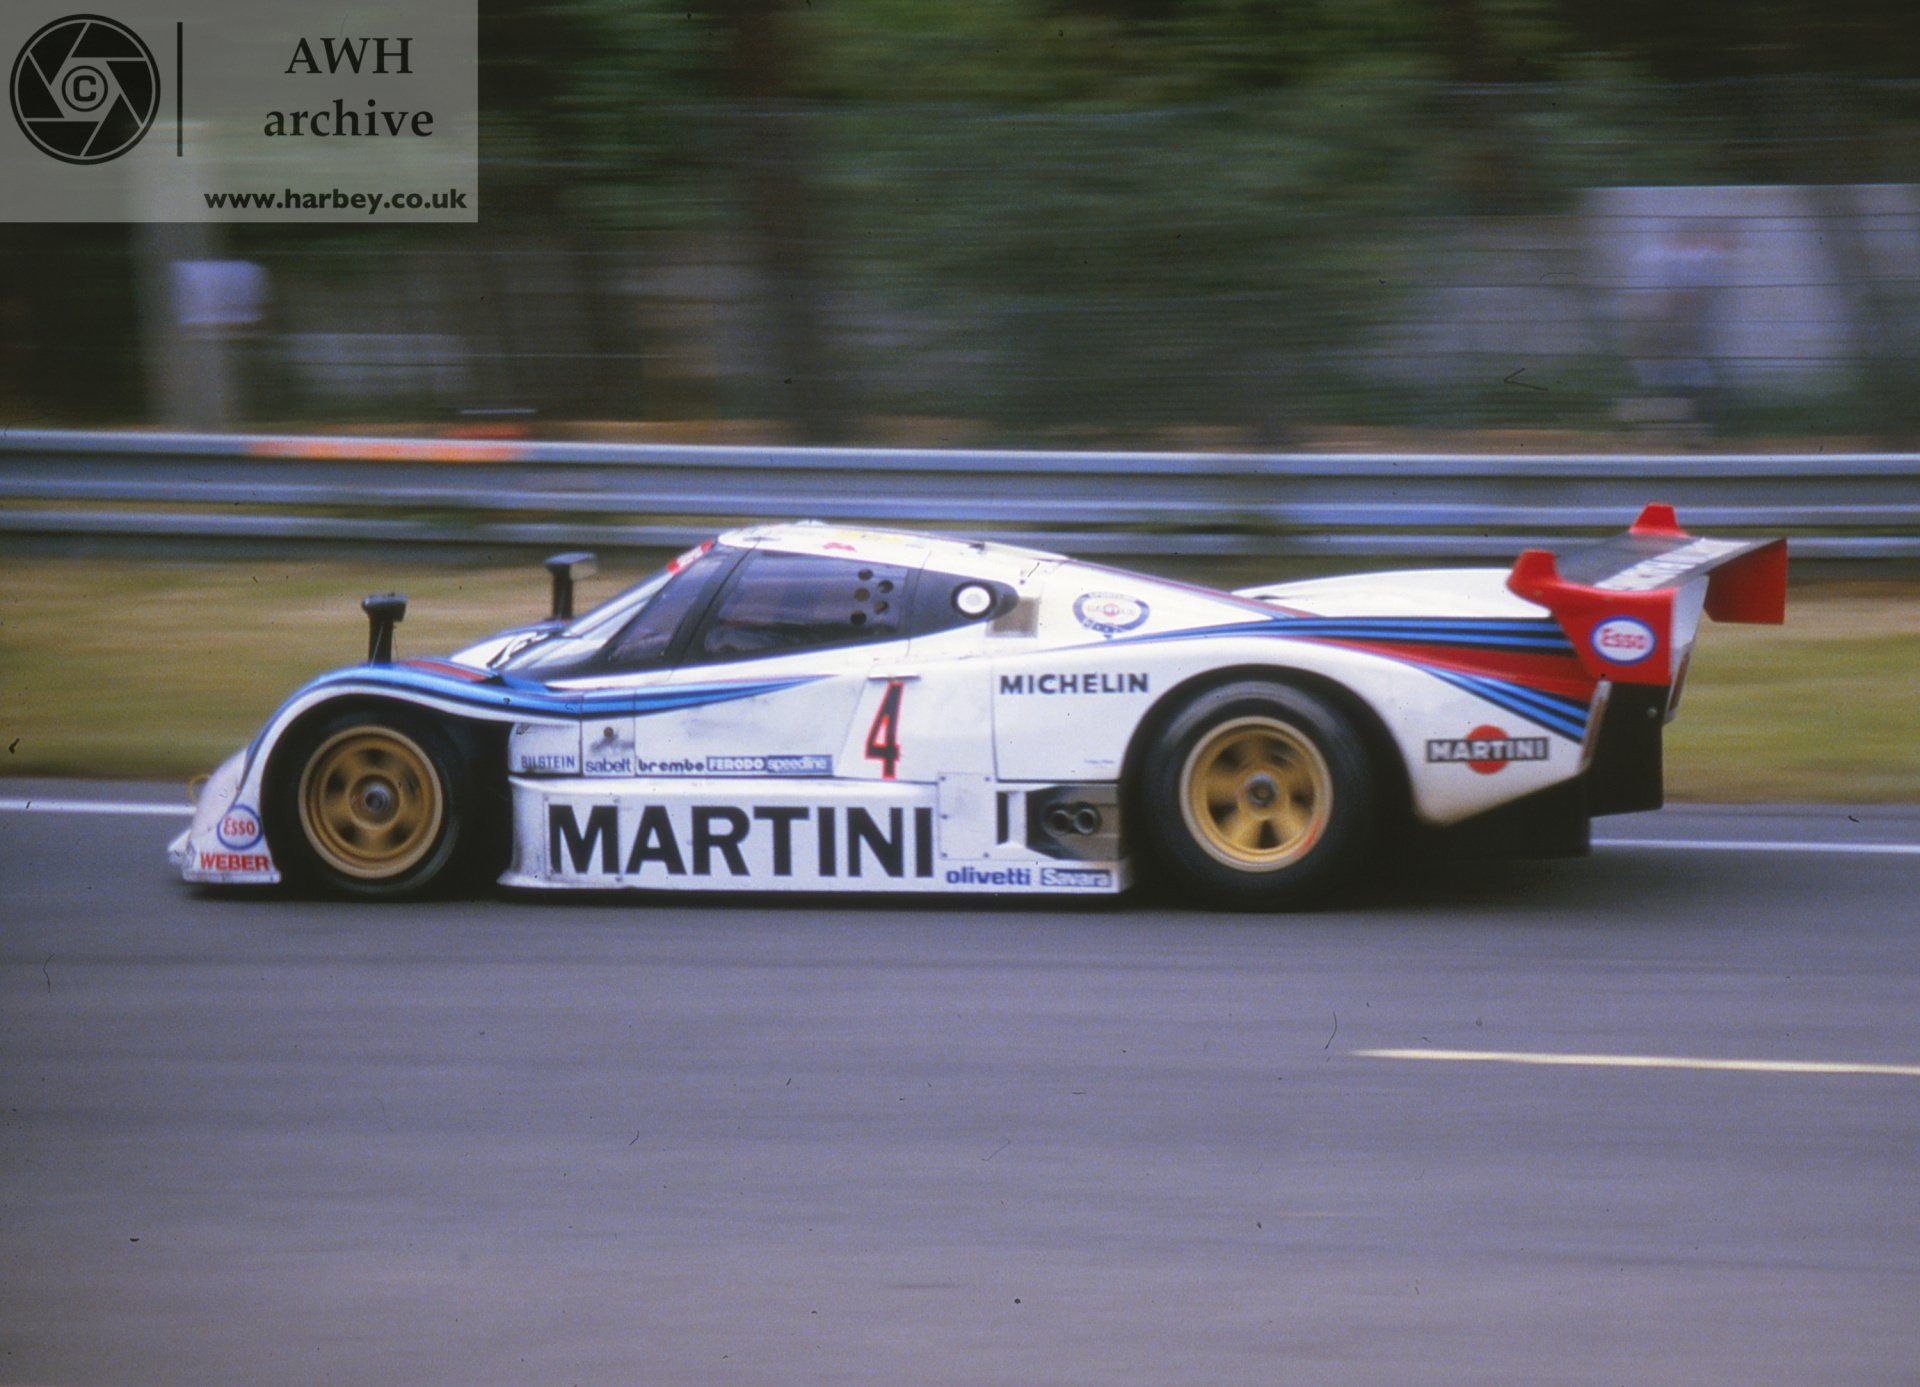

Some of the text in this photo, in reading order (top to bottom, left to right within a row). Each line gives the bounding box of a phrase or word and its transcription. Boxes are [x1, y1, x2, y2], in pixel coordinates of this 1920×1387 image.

[1000, 673, 1149, 694] MICHELIN
[864, 680, 905, 780] 4
[1428, 739, 1545, 761] MARTINI
[521, 756, 575, 770] BILSTEIN
[585, 758, 632, 772] sabelt
[637, 758, 705, 772] brembo
[708, 757, 765, 771] FERODO
[549, 804, 934, 878] MARTINI
[199, 853, 270, 872] WEBER
[946, 866, 1031, 886] olivetti
